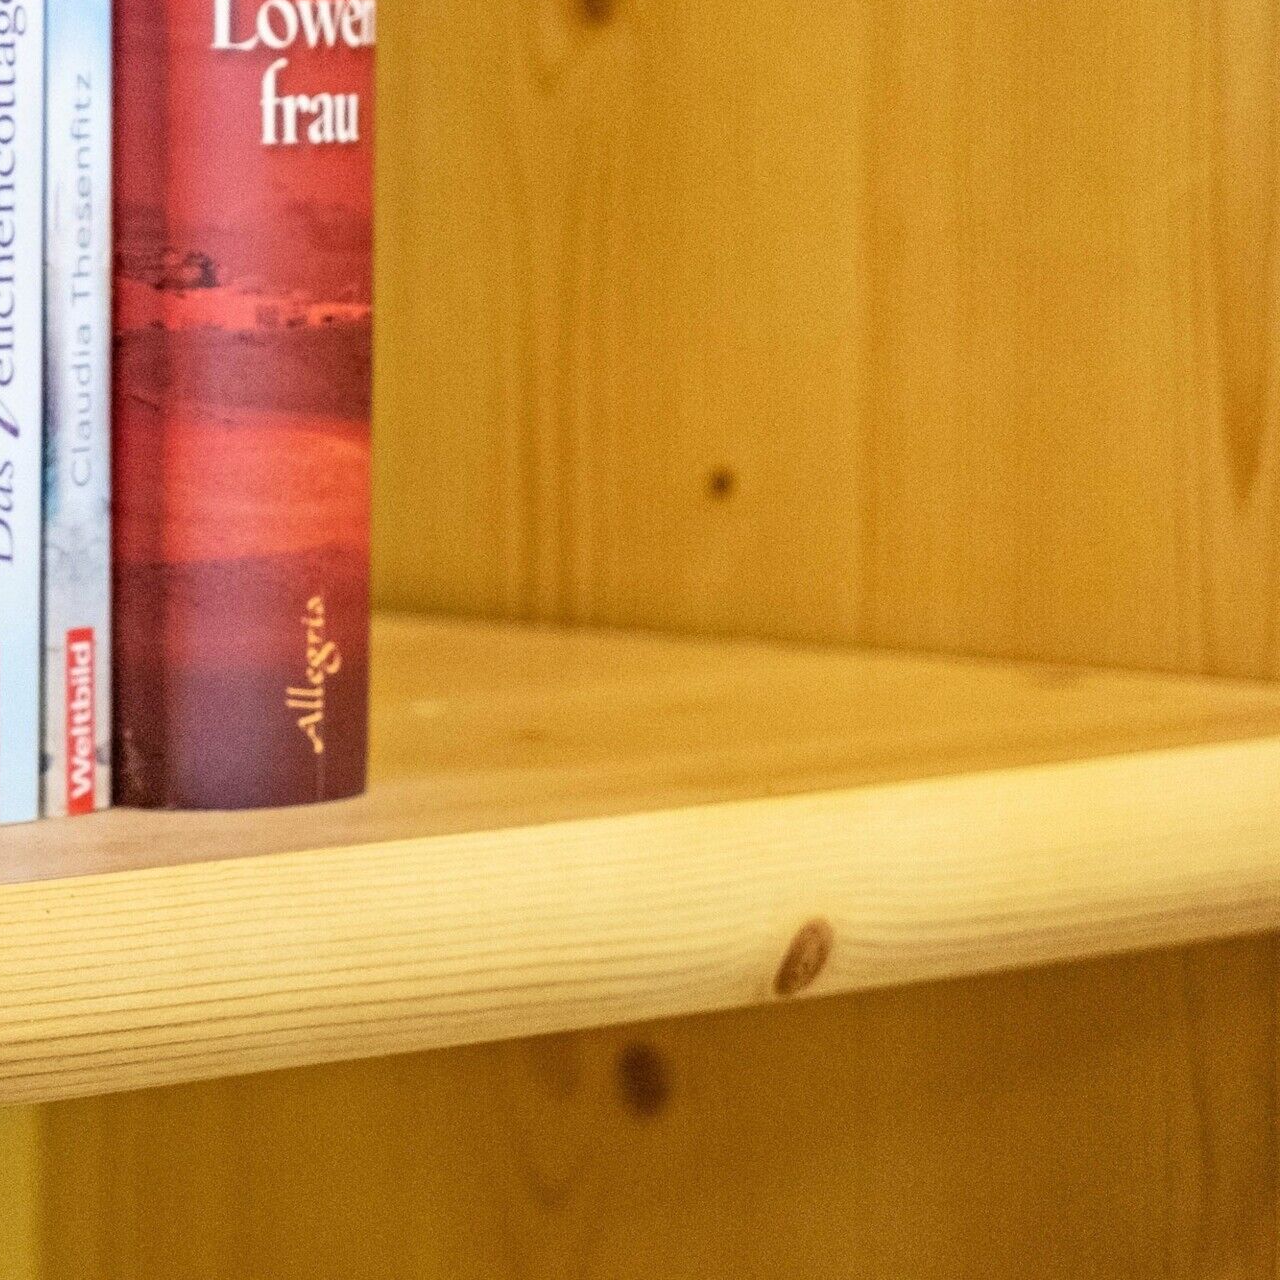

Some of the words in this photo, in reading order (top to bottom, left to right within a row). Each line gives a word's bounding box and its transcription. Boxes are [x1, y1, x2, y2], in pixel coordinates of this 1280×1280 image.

[260, 57, 360, 145] frau
[69, 72, 93, 307] Thesenfitz
[69, 322, 93, 489] Claudia
[69, 641, 93, 800] Weltbild
[285, 595, 342, 756] Allegria
